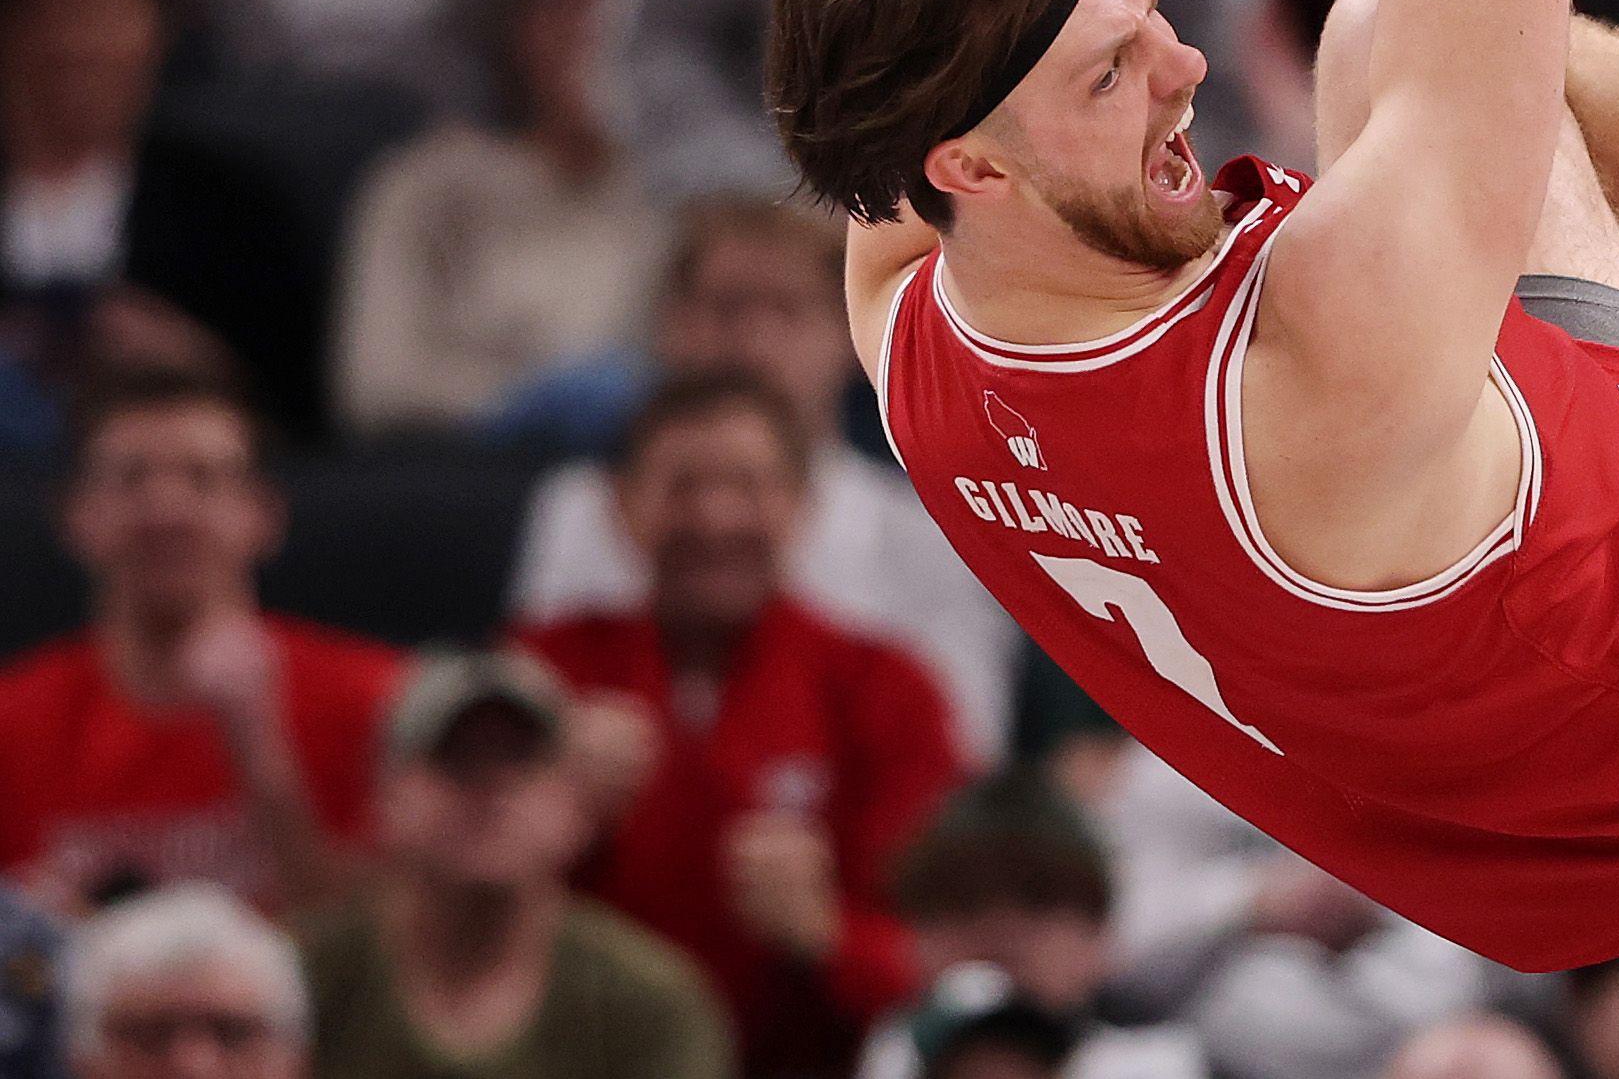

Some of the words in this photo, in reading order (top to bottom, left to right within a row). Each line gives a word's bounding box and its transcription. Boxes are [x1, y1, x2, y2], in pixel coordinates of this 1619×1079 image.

[1007, 435, 1040, 469] W
[954, 475, 1161, 565] GILMORE
[1029, 549, 1286, 756] 7
